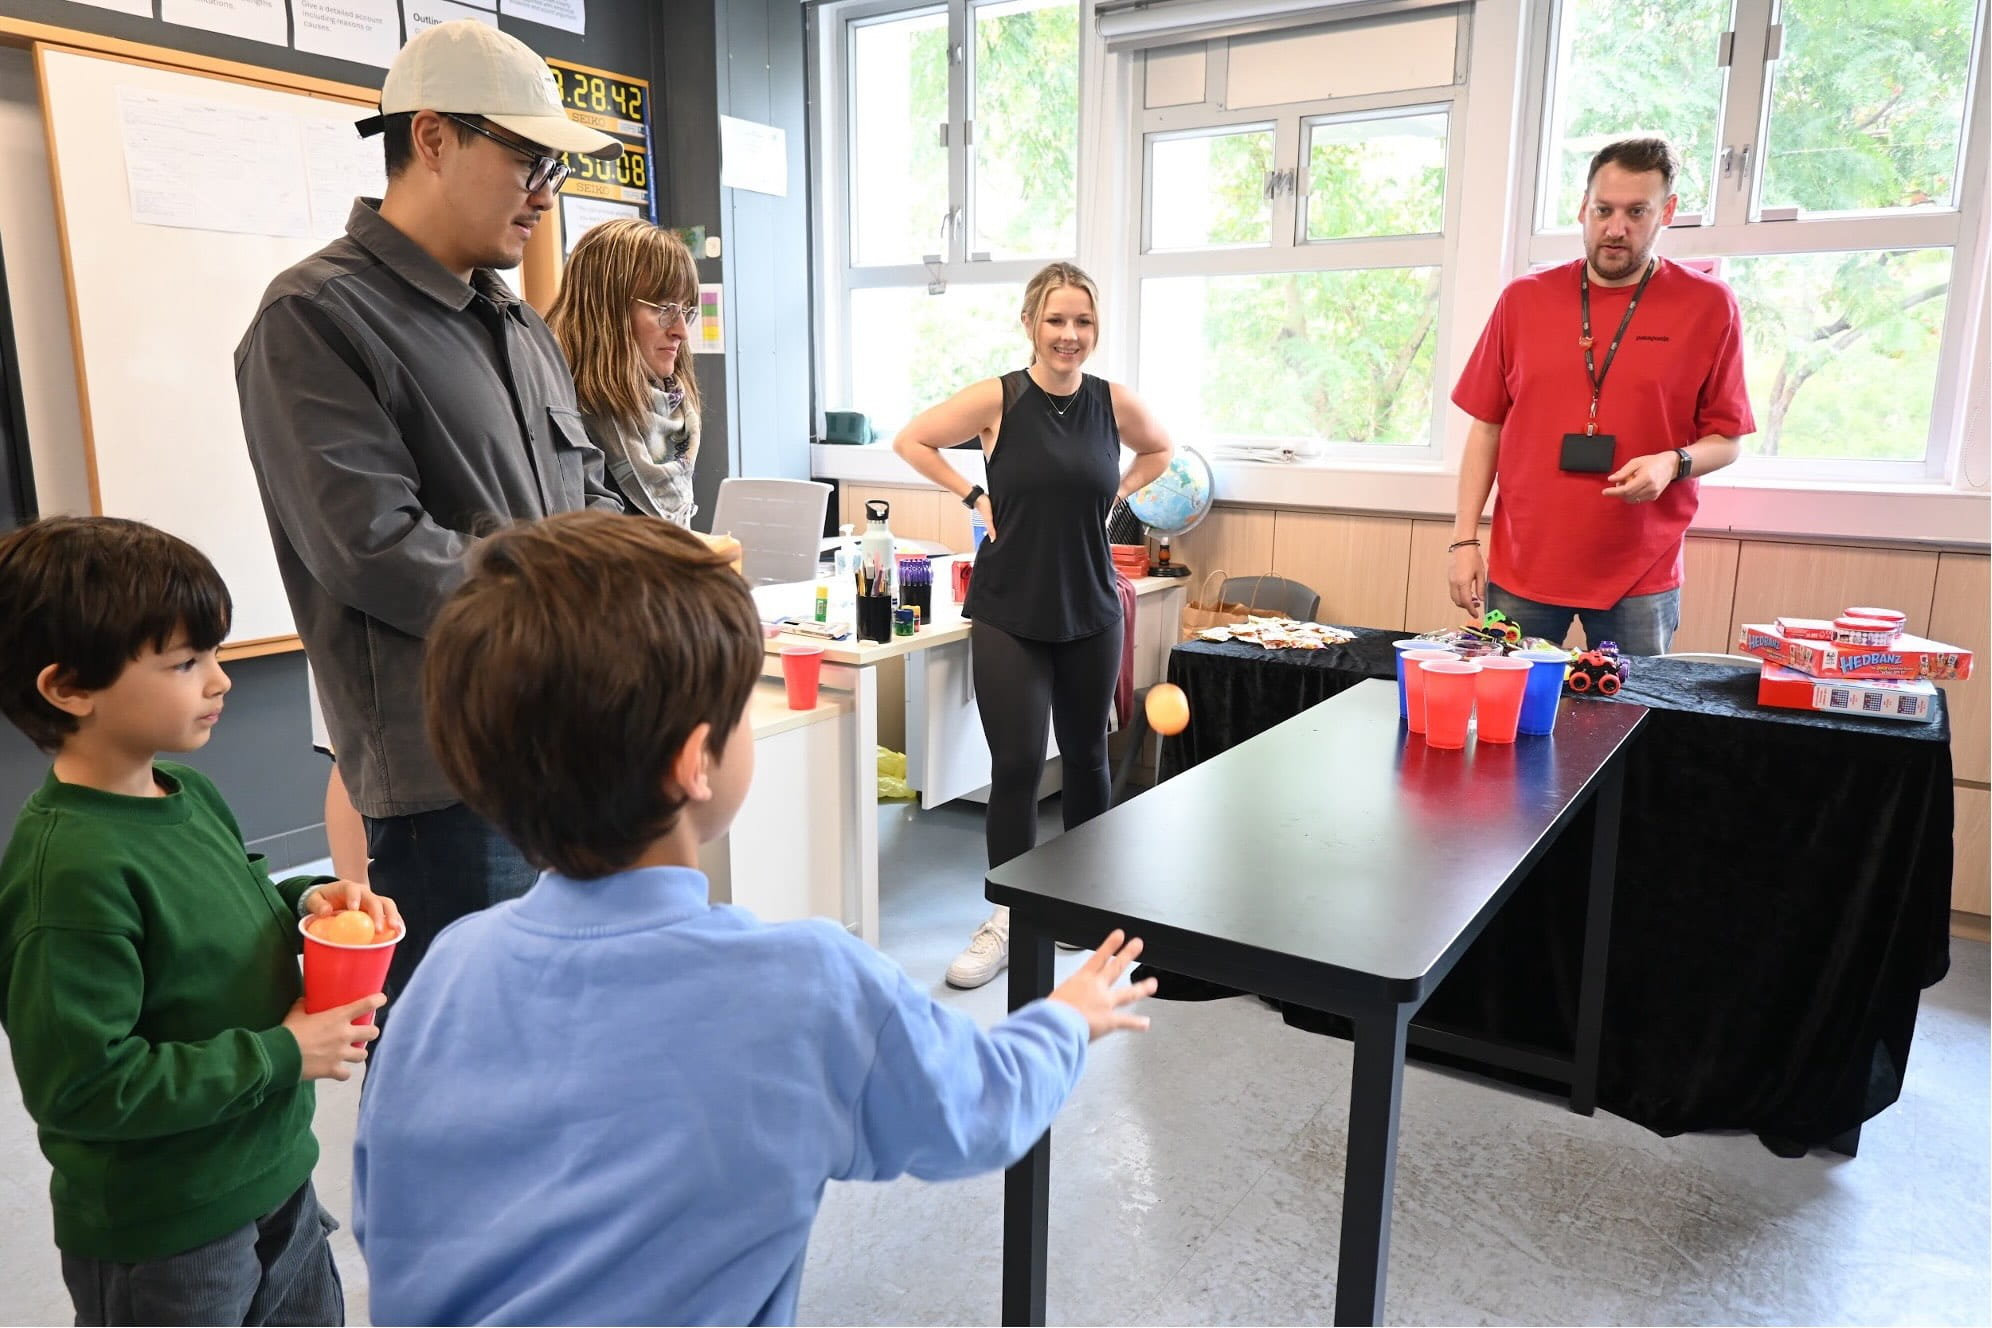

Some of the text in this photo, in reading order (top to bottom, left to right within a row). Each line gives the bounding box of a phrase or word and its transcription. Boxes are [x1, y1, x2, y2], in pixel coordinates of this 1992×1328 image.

[301, 0, 317, 11] Give
[325, 6, 354, 18] detailed
[336, 18, 365, 30] reasons
[413, 12, 443, 25] Outlin
[572, 113, 606, 127] SEIKO
[576, 182, 610, 195] SEIKO
[1748, 635, 1782, 651] HEDBANZ
[1839, 653, 1903, 676] HEDBANZ
